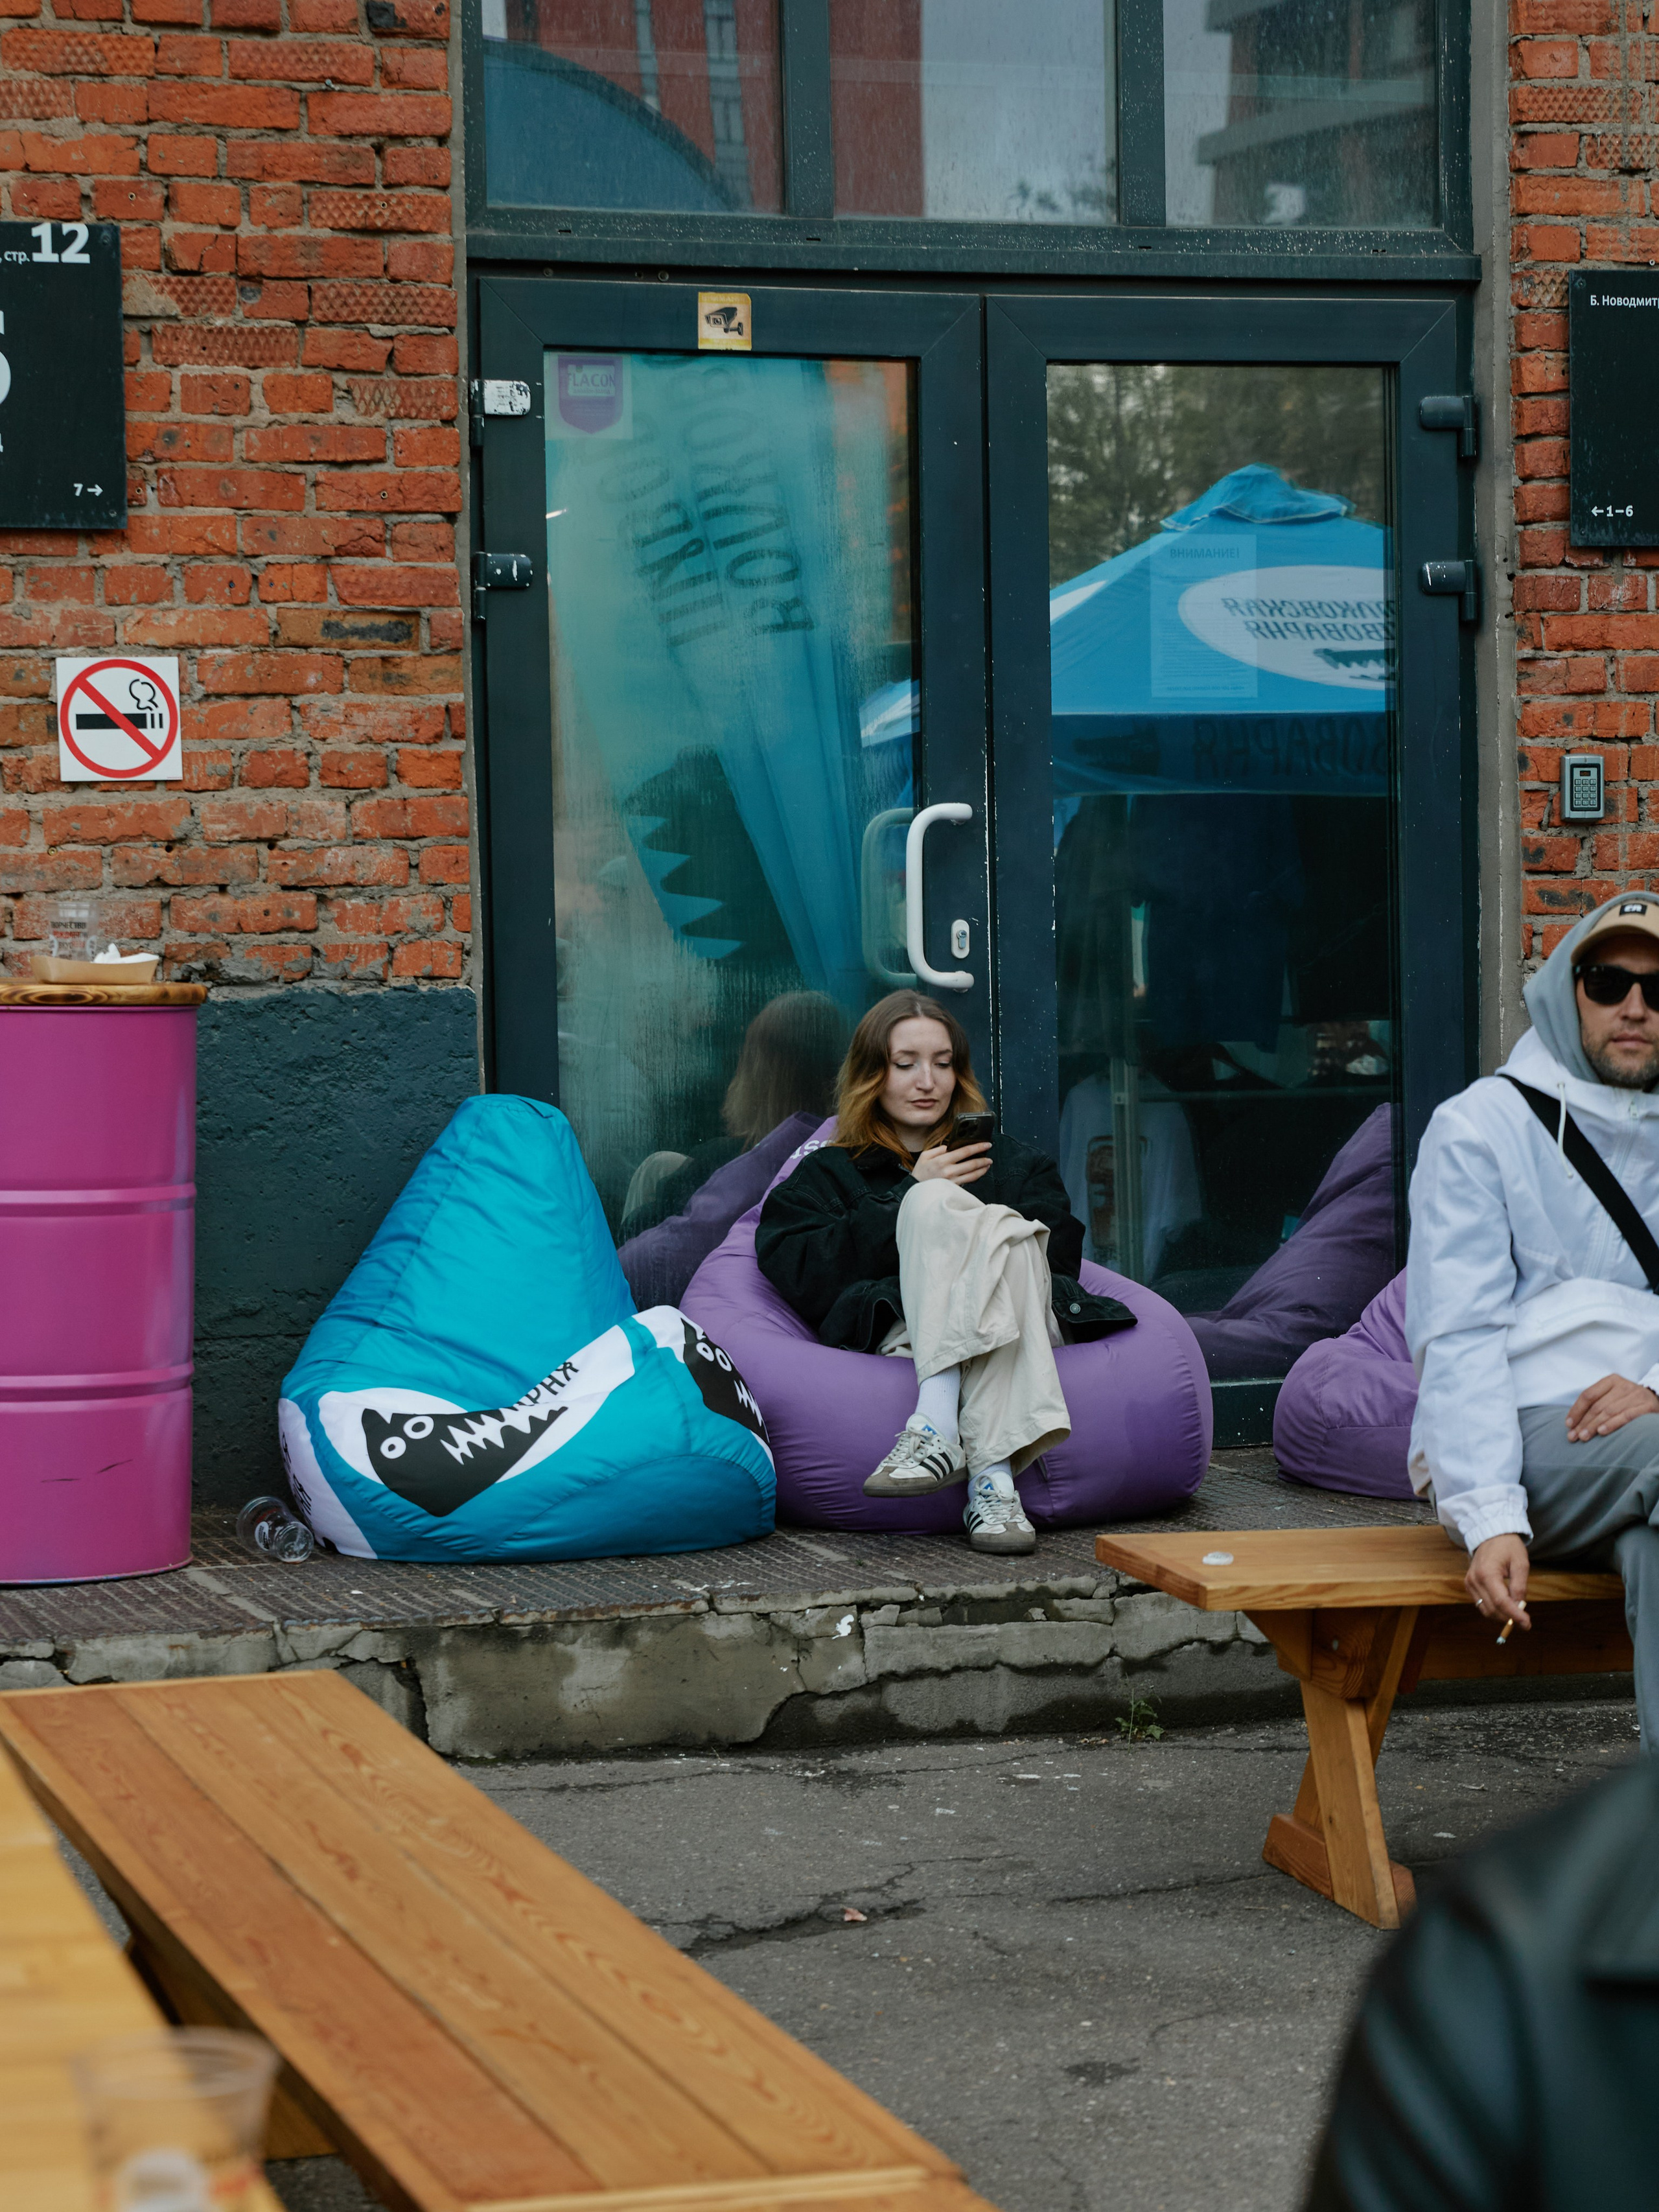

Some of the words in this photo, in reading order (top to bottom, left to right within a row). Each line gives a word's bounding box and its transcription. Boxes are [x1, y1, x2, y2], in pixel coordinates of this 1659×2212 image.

[4, 251, 30, 265] стр.
[31, 222, 90, 264] 12
[1590, 295, 1599, 306] Б.
[1602, 295, 1659, 309] Новодмит
[73, 483, 83, 496] 7
[1170, 547, 1240, 560] ВНИМАНИЕ!
